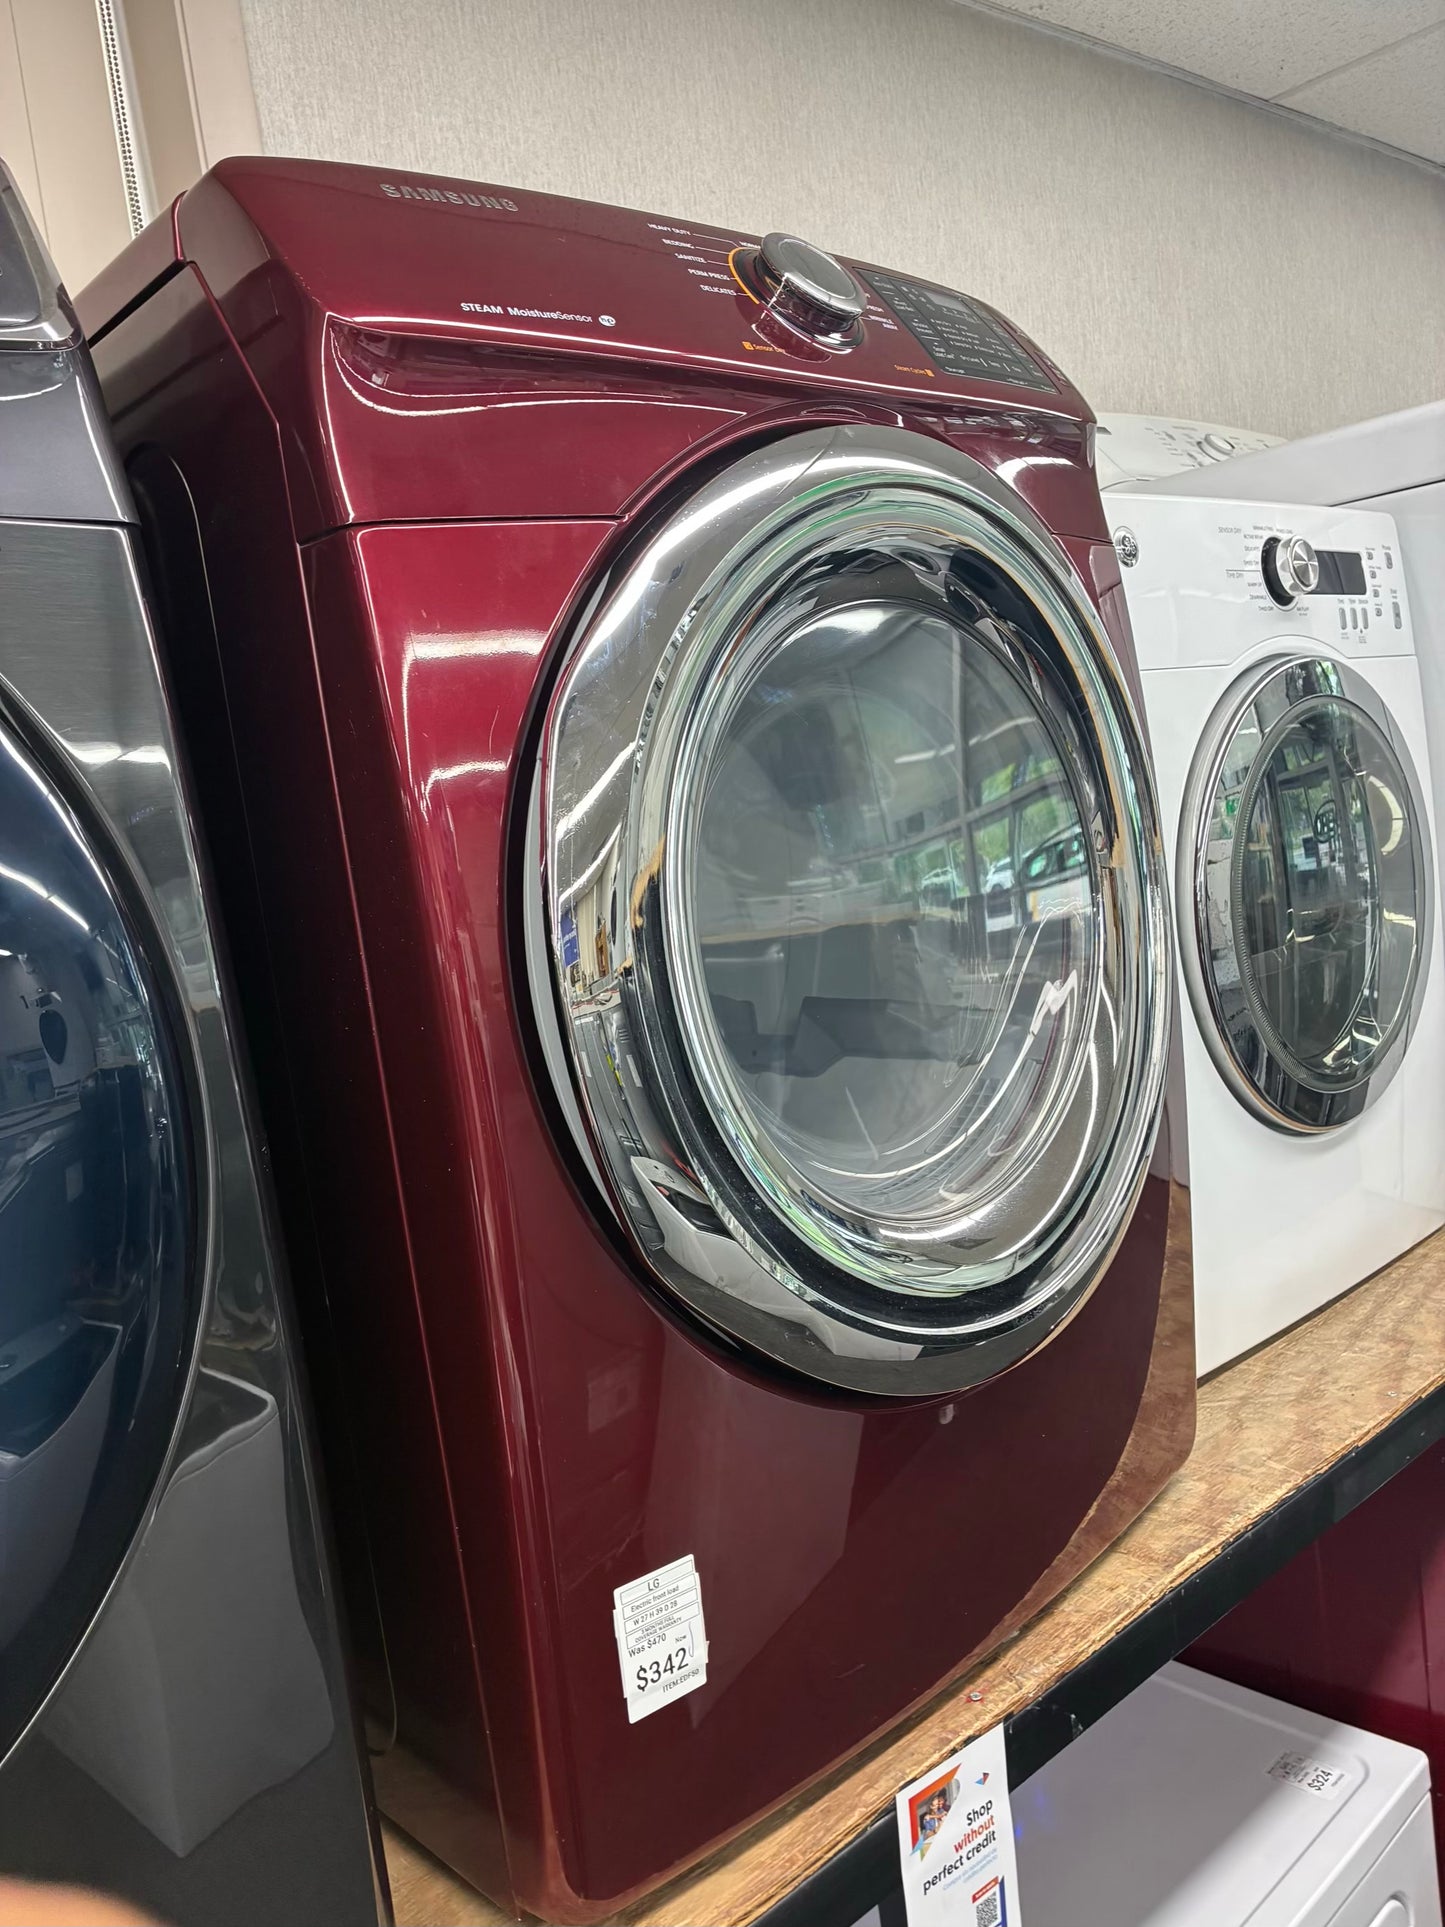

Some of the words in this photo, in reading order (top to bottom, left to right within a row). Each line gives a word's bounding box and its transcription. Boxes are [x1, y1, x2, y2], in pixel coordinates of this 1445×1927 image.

[379, 183, 518, 212] SAMSUNG
[460, 302, 504, 314] STEAM
[506, 306, 592, 323] MoistureSensor
[647, 1578, 660, 1592] LG
[630, 1598, 652, 1612] Electric
[652, 1592, 666, 1602] front
[667, 1585, 679, 1595] load
[640, 1614, 648, 1622] 27
[656, 1607, 663, 1615] 39
[670, 1600, 678, 1609] 28
[628, 1645, 646, 1657] Was
[647, 1633, 666, 1649] $470
[675, 1634, 687, 1643] Now
[636, 1647, 689, 1692] $342
[1307, 1769, 1333, 1791] $324
[966, 1798, 993, 1826] Shop
[953, 1814, 995, 1854] without
[922, 1853, 964, 1896] perfect
[966, 1830, 997, 1861] credit
